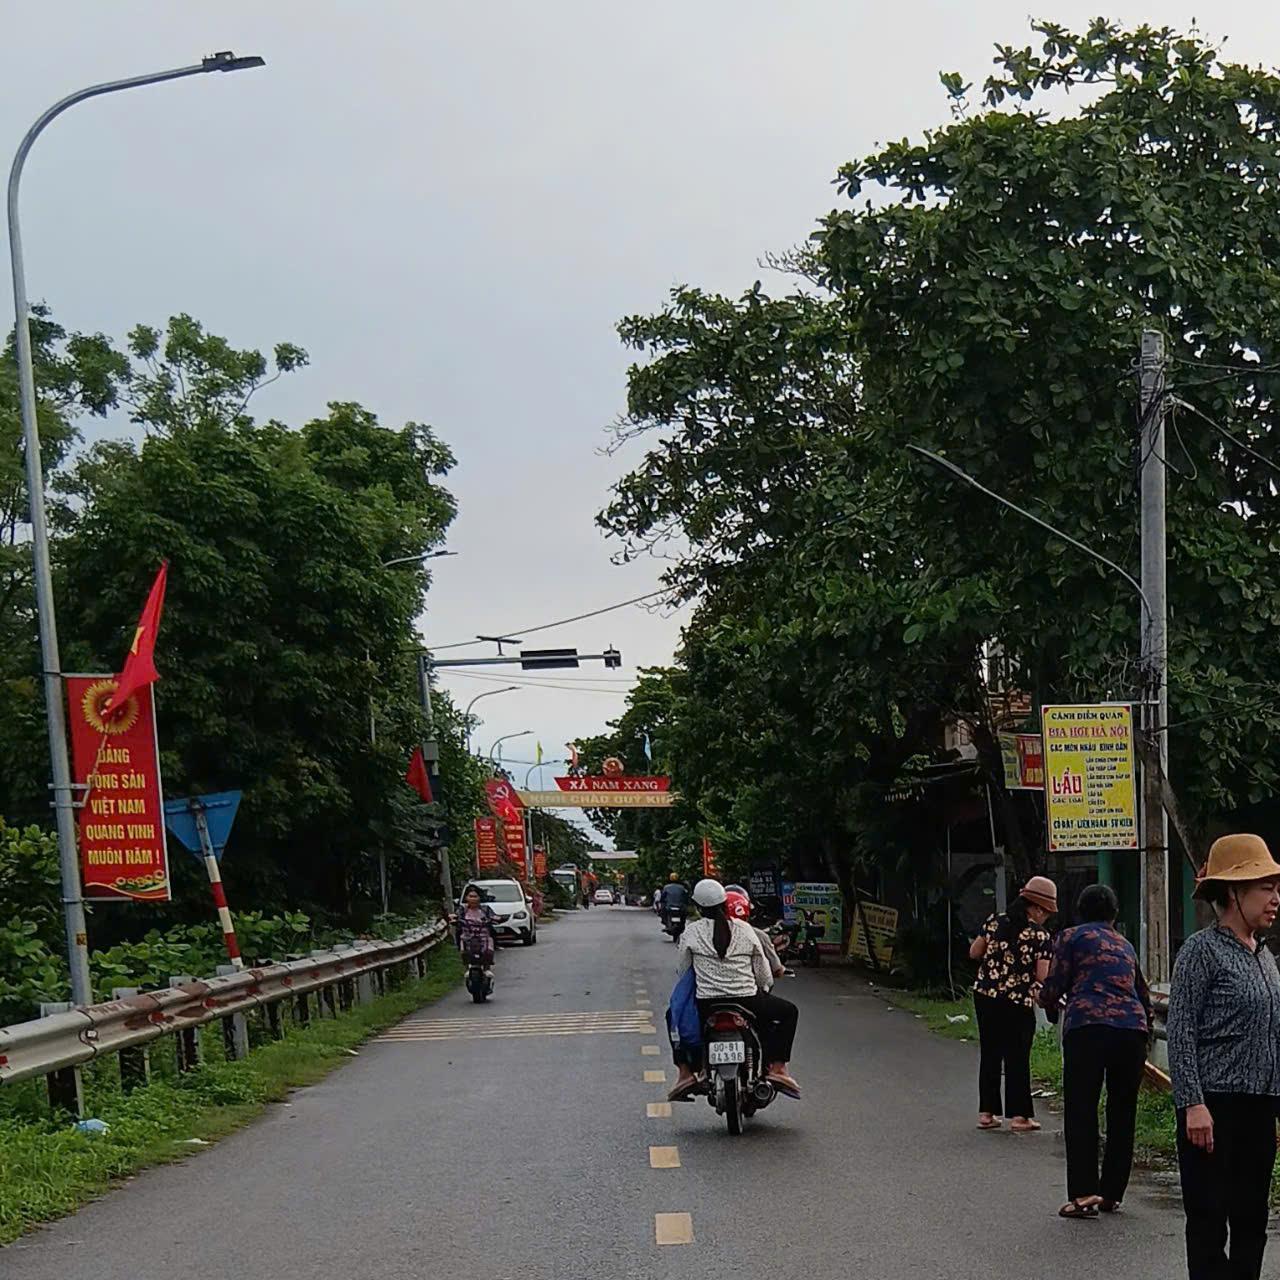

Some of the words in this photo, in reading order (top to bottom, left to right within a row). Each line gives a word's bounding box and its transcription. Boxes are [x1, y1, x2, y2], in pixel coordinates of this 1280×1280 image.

[121, 769, 146, 789] SẢN
[592, 780, 619, 790] NAM
[624, 780, 659, 790] XANG
[1052, 767, 1082, 794] LẨU
[90, 796, 116, 818] VIỆT
[118, 799, 146, 814] NAM
[85, 824, 125, 841] QUANG
[127, 824, 155, 839] VINH
[88, 847, 122, 865] MUÔN
